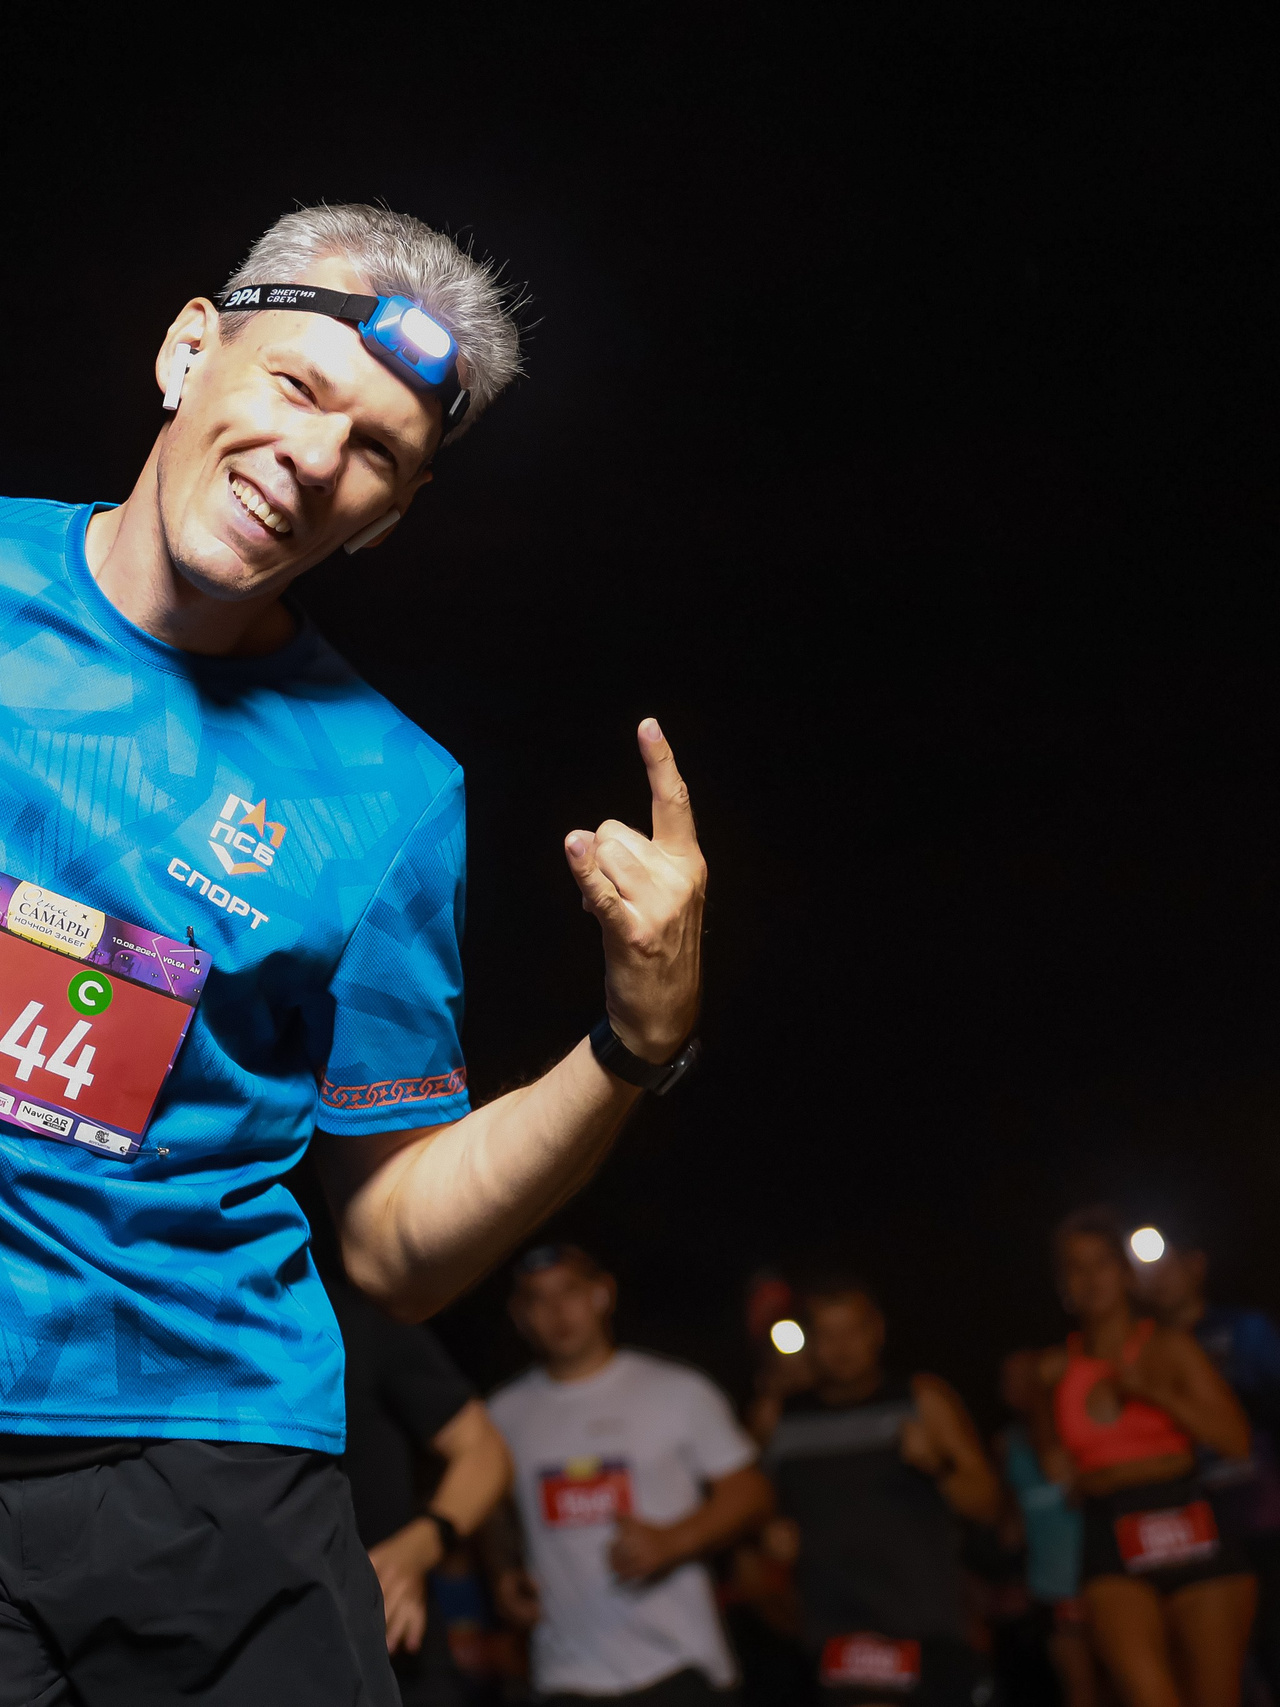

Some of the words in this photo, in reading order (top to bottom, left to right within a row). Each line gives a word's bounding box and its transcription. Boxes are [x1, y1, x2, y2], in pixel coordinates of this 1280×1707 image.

[225, 287, 262, 307] ЭРА
[266, 295, 297, 304] СВЕТА
[270, 288, 316, 299] ЭНЕРГИЯ
[210, 820, 276, 867] ПСБ
[167, 857, 269, 930] СПОРТ
[14, 916, 53, 936] НОЧНОЙ
[54, 932, 85, 948] ЗАБЕГ
[19, 902, 91, 940] САМАРЫ
[112, 936, 157, 958] 10.08.2024
[163, 956, 185, 970] VOLGA
[22, 1105, 69, 1128] NaviGAR
